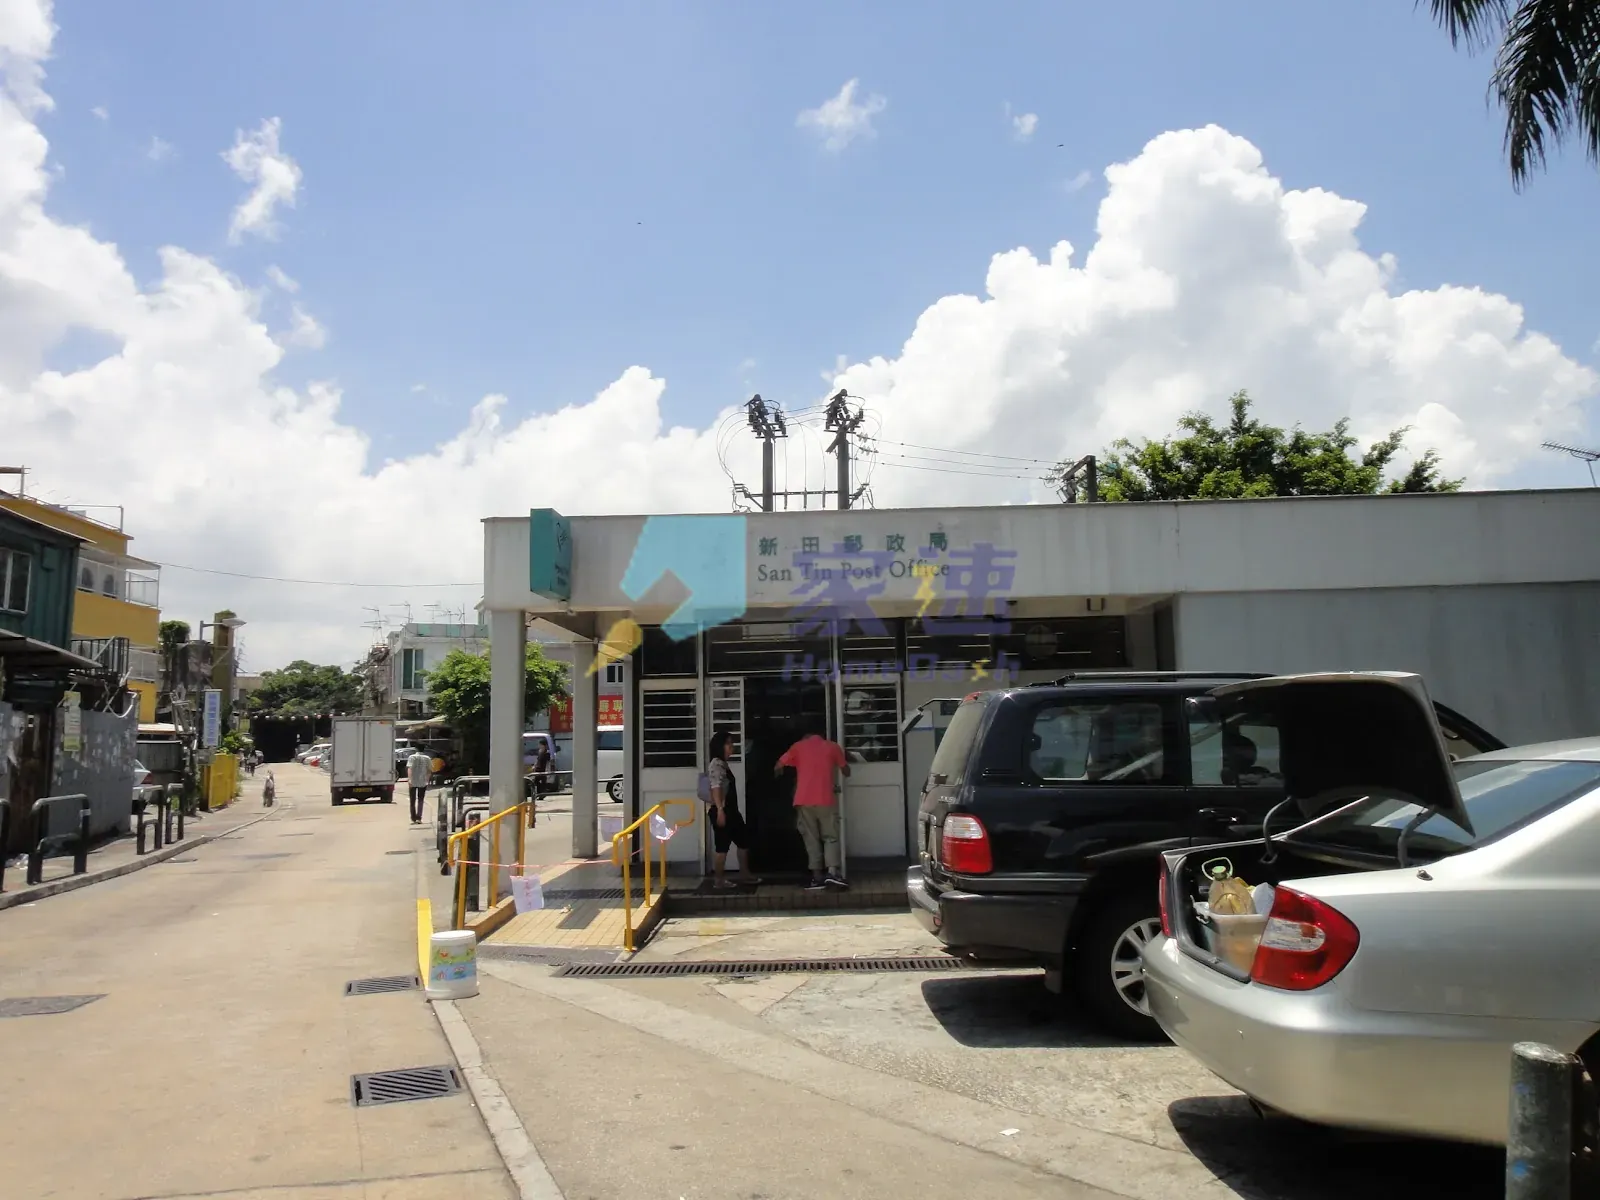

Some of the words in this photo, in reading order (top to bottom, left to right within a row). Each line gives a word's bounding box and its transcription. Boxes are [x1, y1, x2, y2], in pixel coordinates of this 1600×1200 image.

[758, 532, 948, 556] 新田郵政局
[757, 563, 792, 582] San
[799, 562, 832, 580] Tin
[840, 560, 880, 580] Post
[889, 558, 950, 578] Office
